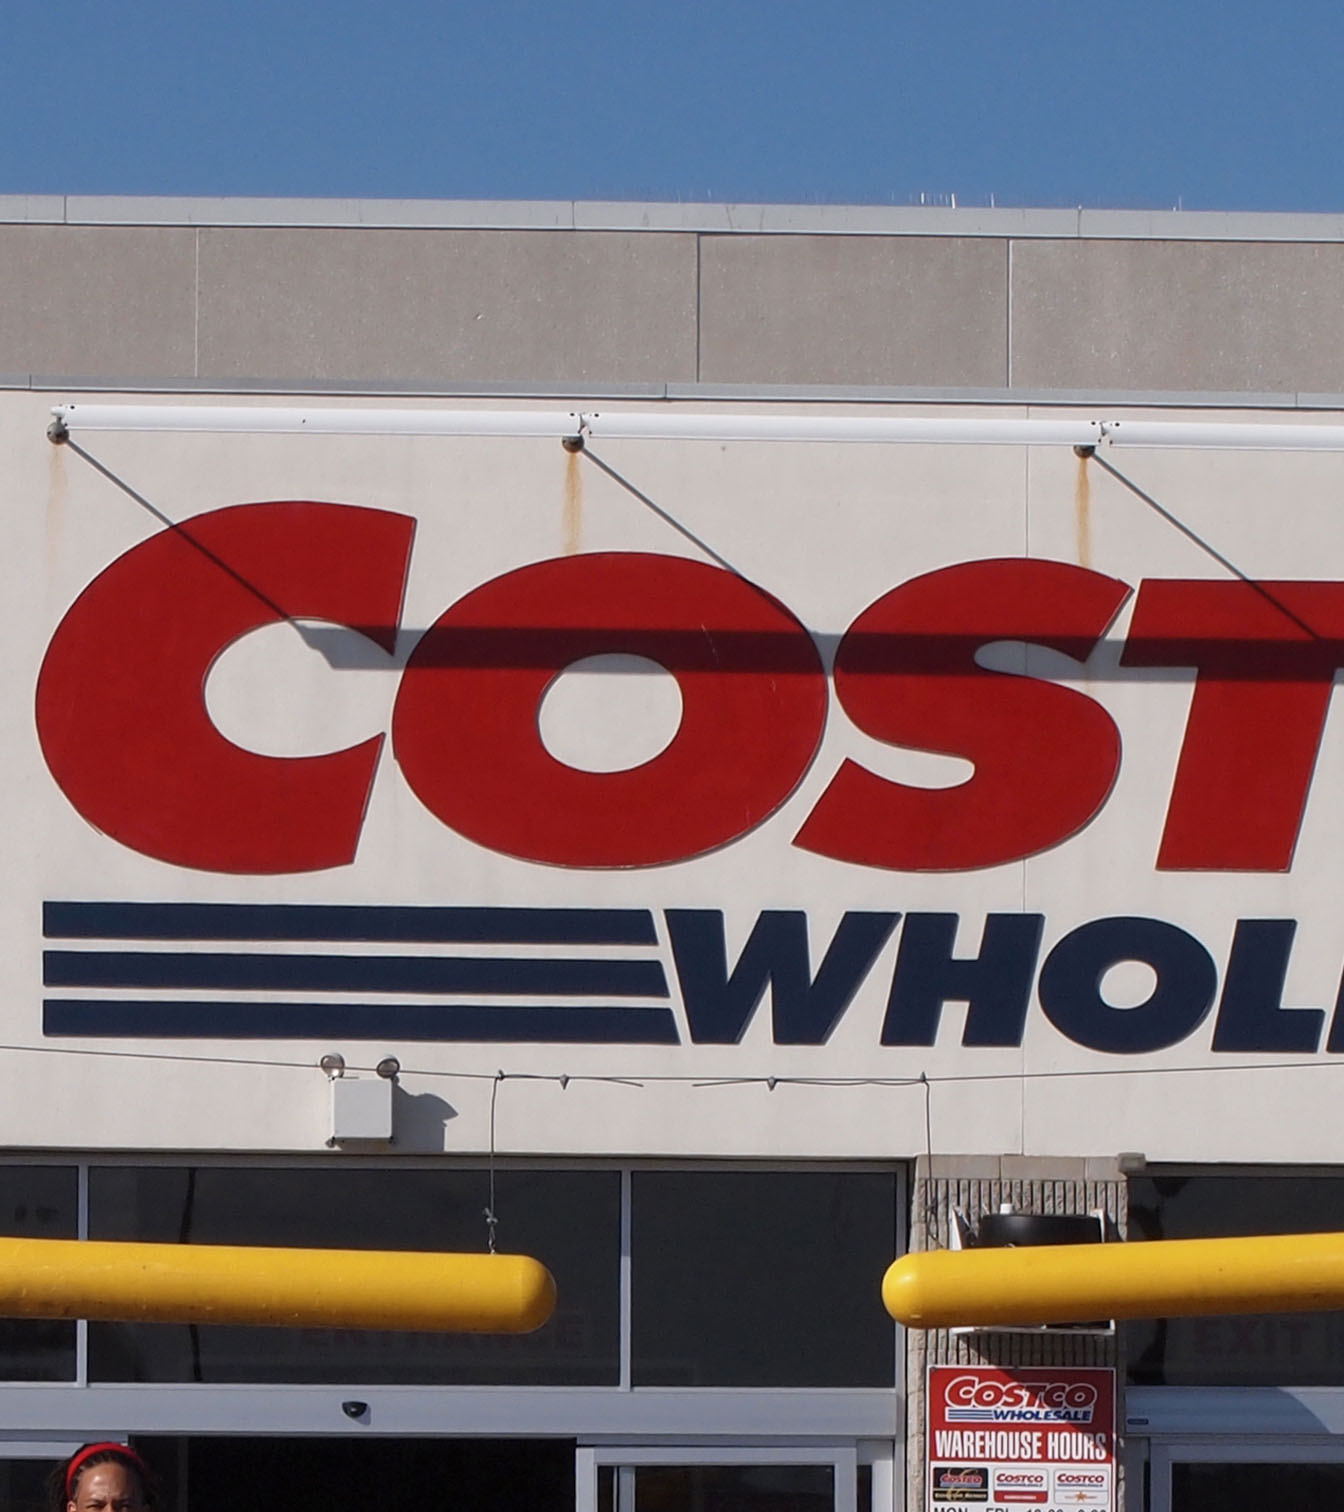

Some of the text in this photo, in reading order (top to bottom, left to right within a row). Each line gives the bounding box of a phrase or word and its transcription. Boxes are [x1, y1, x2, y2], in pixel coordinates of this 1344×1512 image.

[944, 1375, 1098, 1409] COSTCO
[993, 1409, 1091, 1421] WHOLESALE
[935, 1430, 1107, 1460] WAREHOUSE HOURS
[996, 1473, 1044, 1482] COSTCO
[1057, 1473, 1105, 1483] COSTCO
